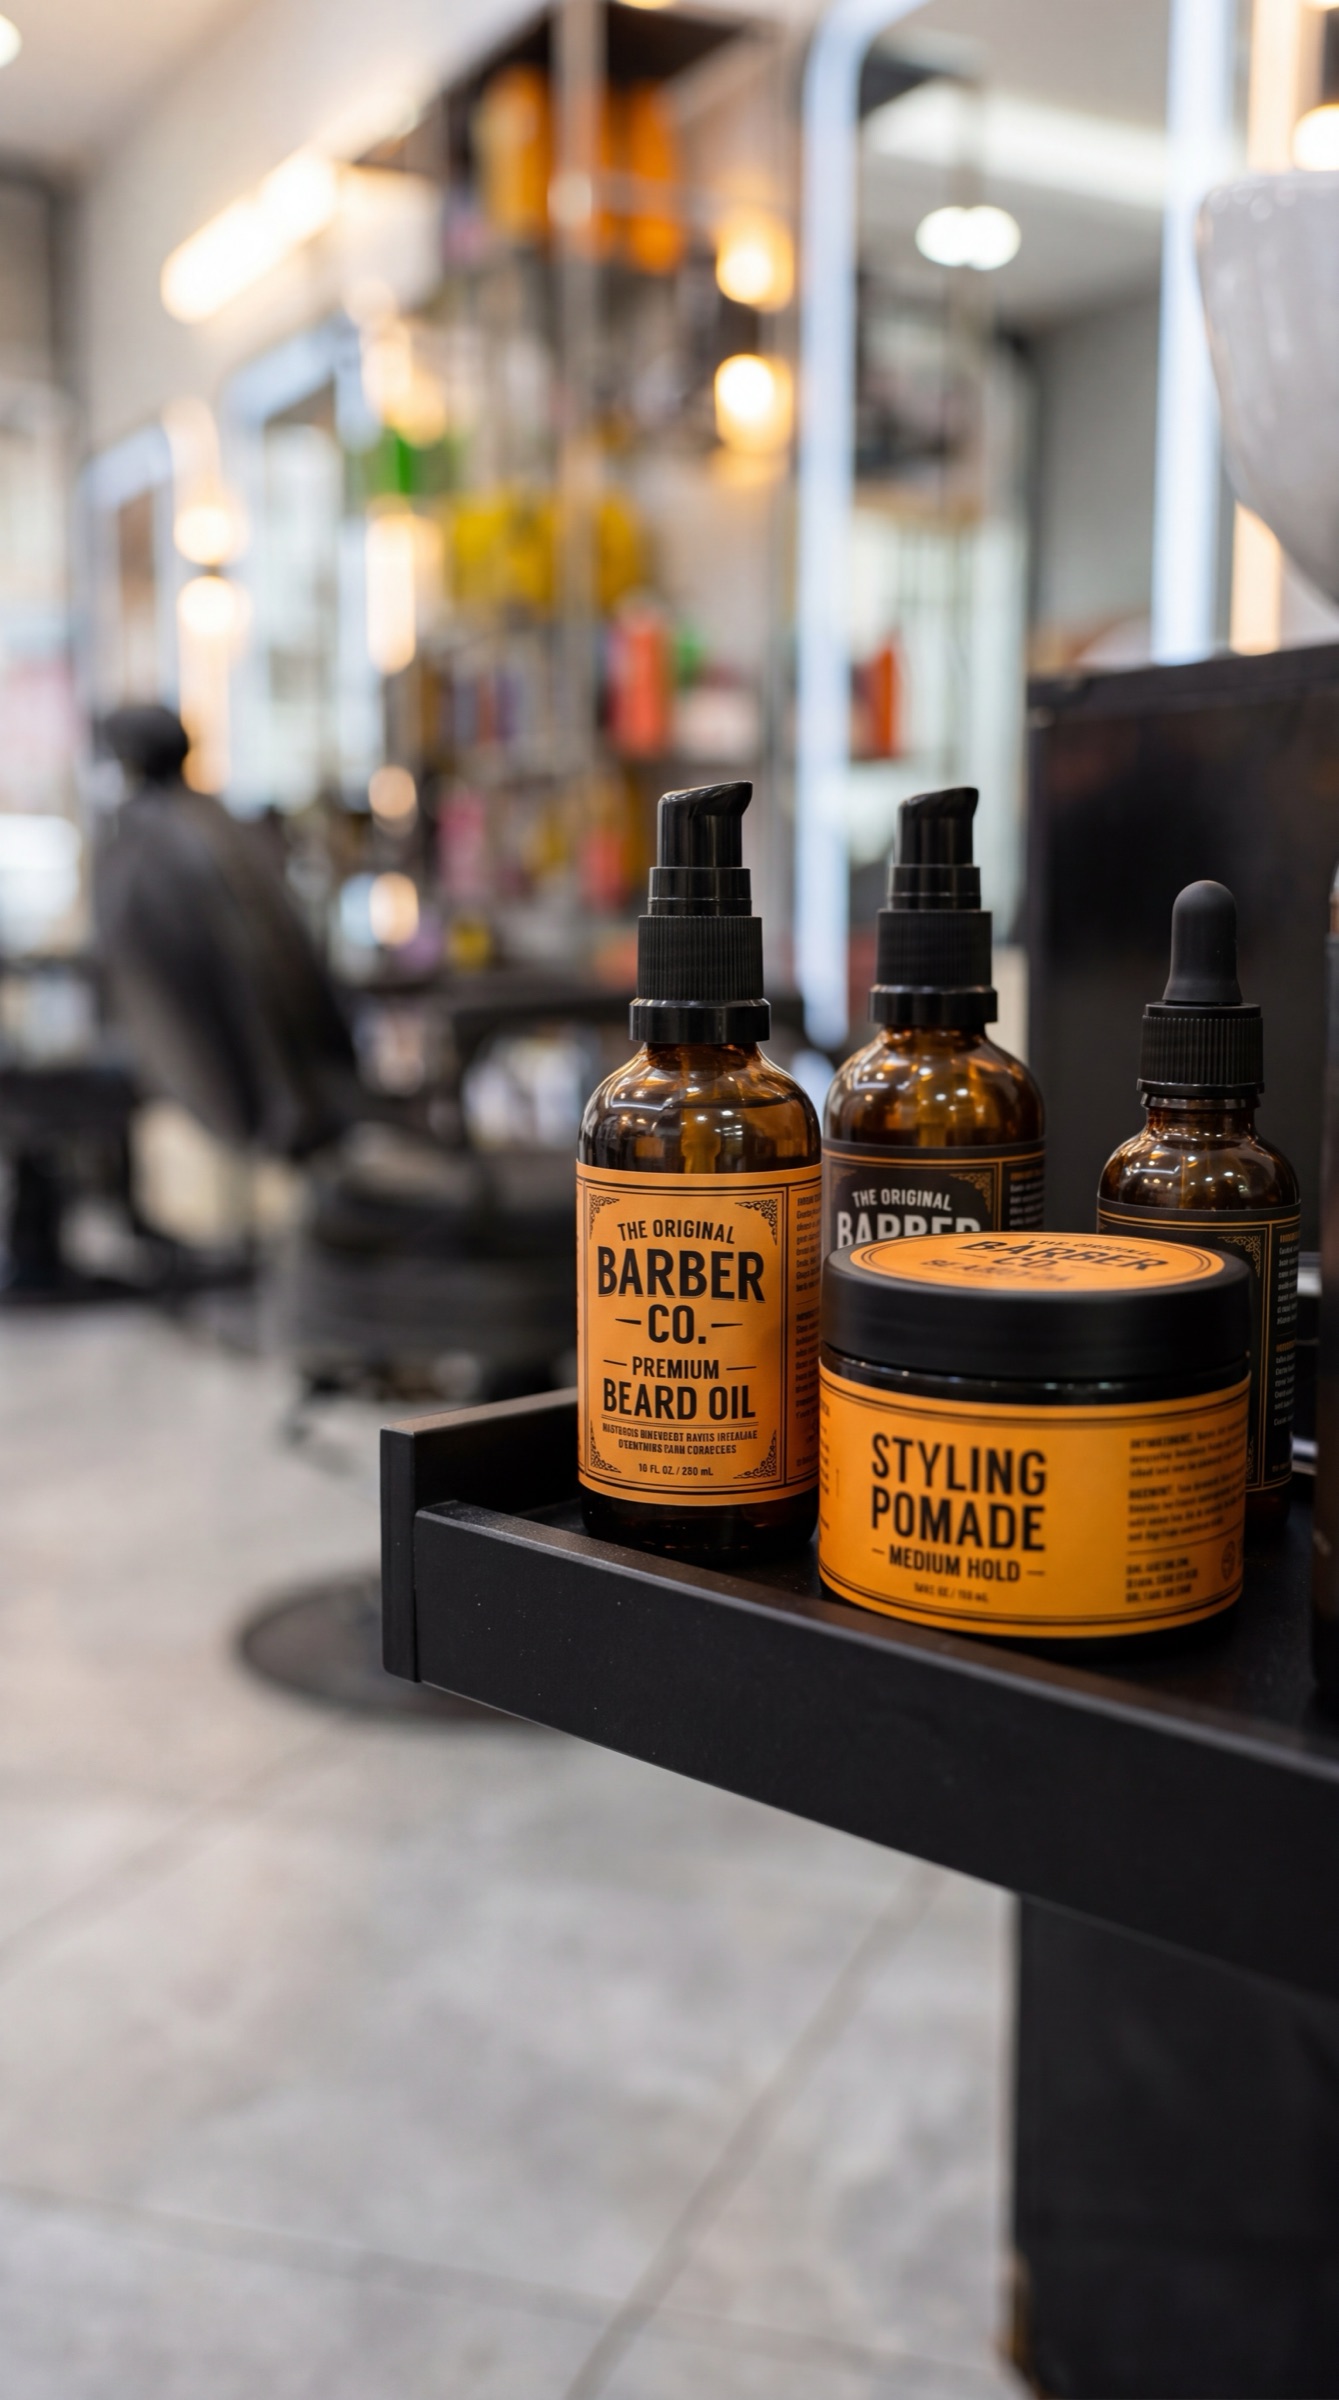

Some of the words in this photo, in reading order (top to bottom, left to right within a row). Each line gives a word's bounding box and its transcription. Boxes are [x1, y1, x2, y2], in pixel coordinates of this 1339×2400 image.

[852, 1191, 878, 1208] THE
[881, 1188, 953, 1212] ORIGINAL
[617, 1220, 648, 1241] THE
[652, 1219, 735, 1244] ORIGINAL
[597, 1245, 766, 1303] BARBER
[956, 1240, 1169, 1272] BARBER
[648, 1304, 706, 1344] CO.
[632, 1356, 719, 1379] PREMIUM
[603, 1377, 697, 1420] BEARD
[709, 1384, 755, 1420] OIL
[871, 1432, 1047, 1497] STYLING
[871, 1484, 1046, 1551] POMADE
[889, 1544, 961, 1578] MEDIUM
[967, 1557, 1021, 1582] HOLD
